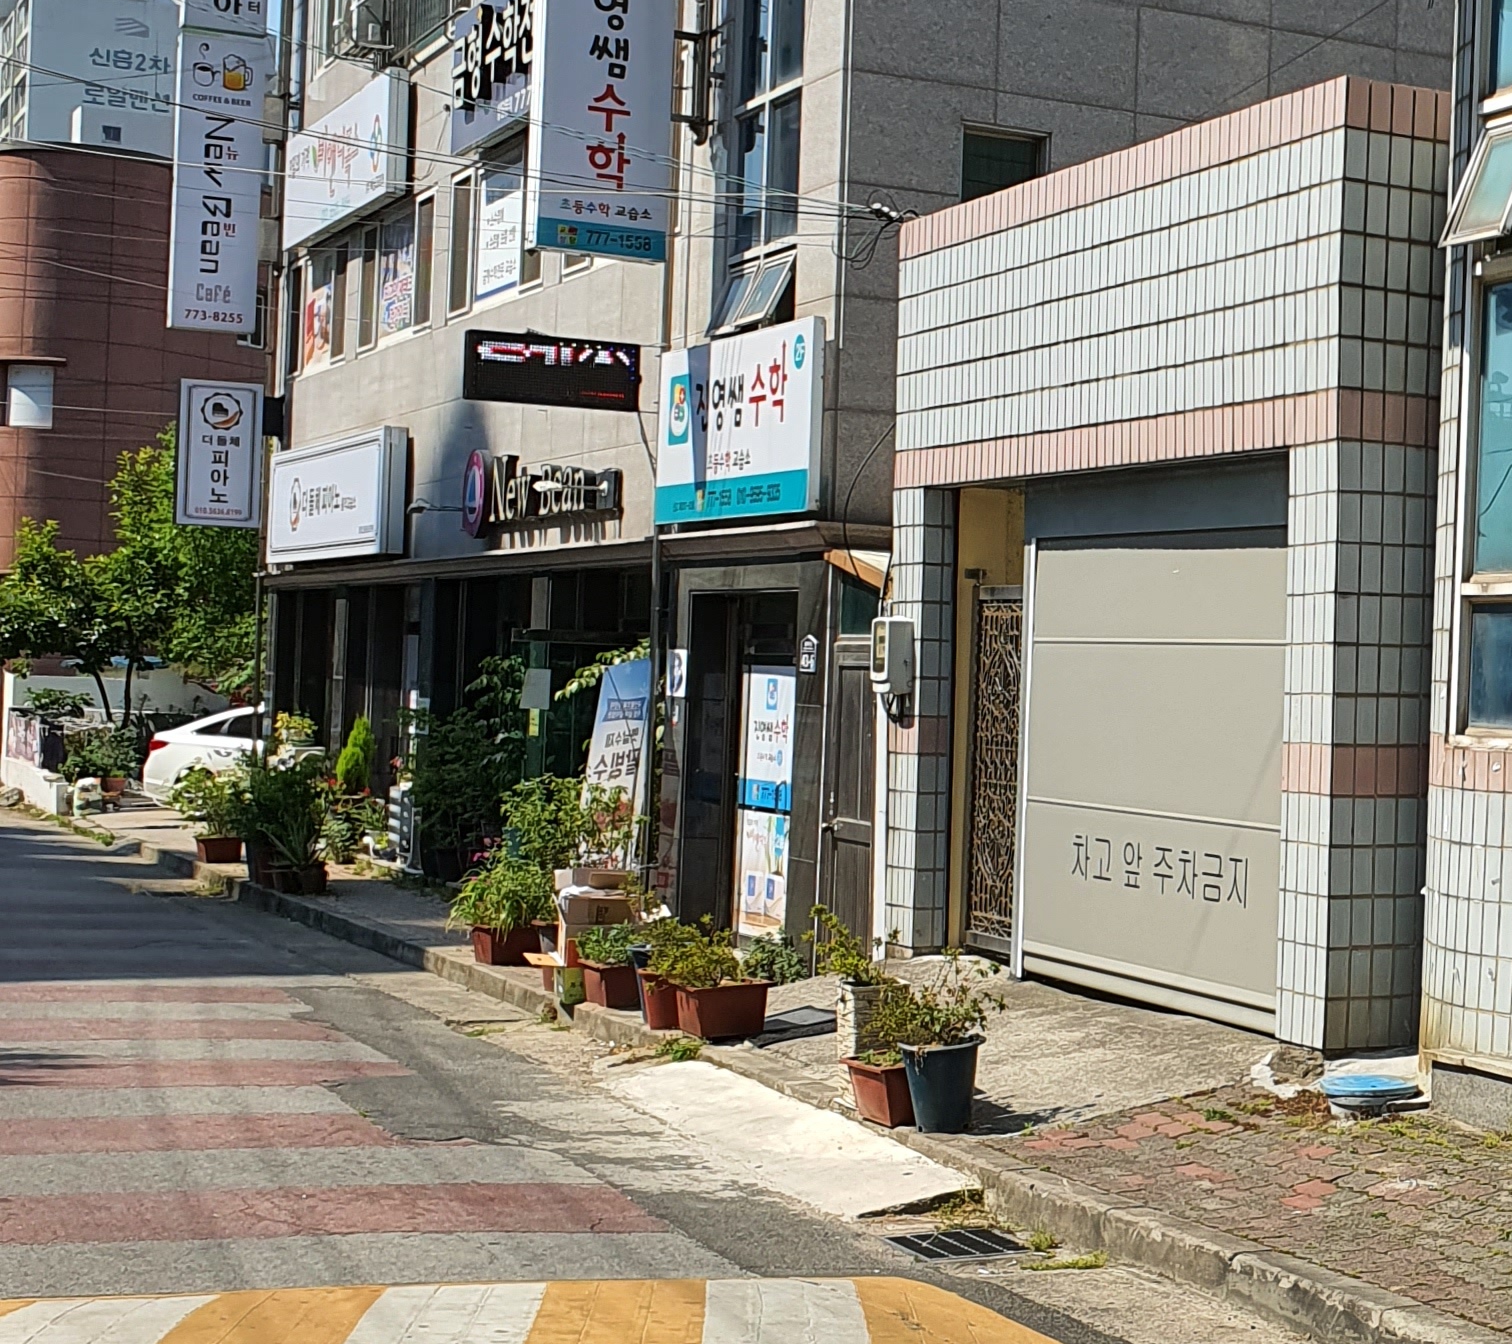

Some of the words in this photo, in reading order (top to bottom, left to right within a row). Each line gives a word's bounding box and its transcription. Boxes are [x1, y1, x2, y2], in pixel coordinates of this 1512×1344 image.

[89, 47, 172, 74] 신흥2차
[204, 116, 236, 187] New
[200, 195, 232, 274] Bean
[560, 198, 612, 219] 초등수학
[614, 205, 653, 222] 교습소
[585, 229, 652, 252] 777-1558
[184, 309, 243, 323] 773-8255
[209, 450, 229, 504] 피아노
[488, 455, 531, 523] New
[538, 464, 585, 516] Bean
[1071, 833, 1113, 883] 차고
[1123, 841, 1142, 890] 앞
[1152, 845, 1249, 910] 주차금지
